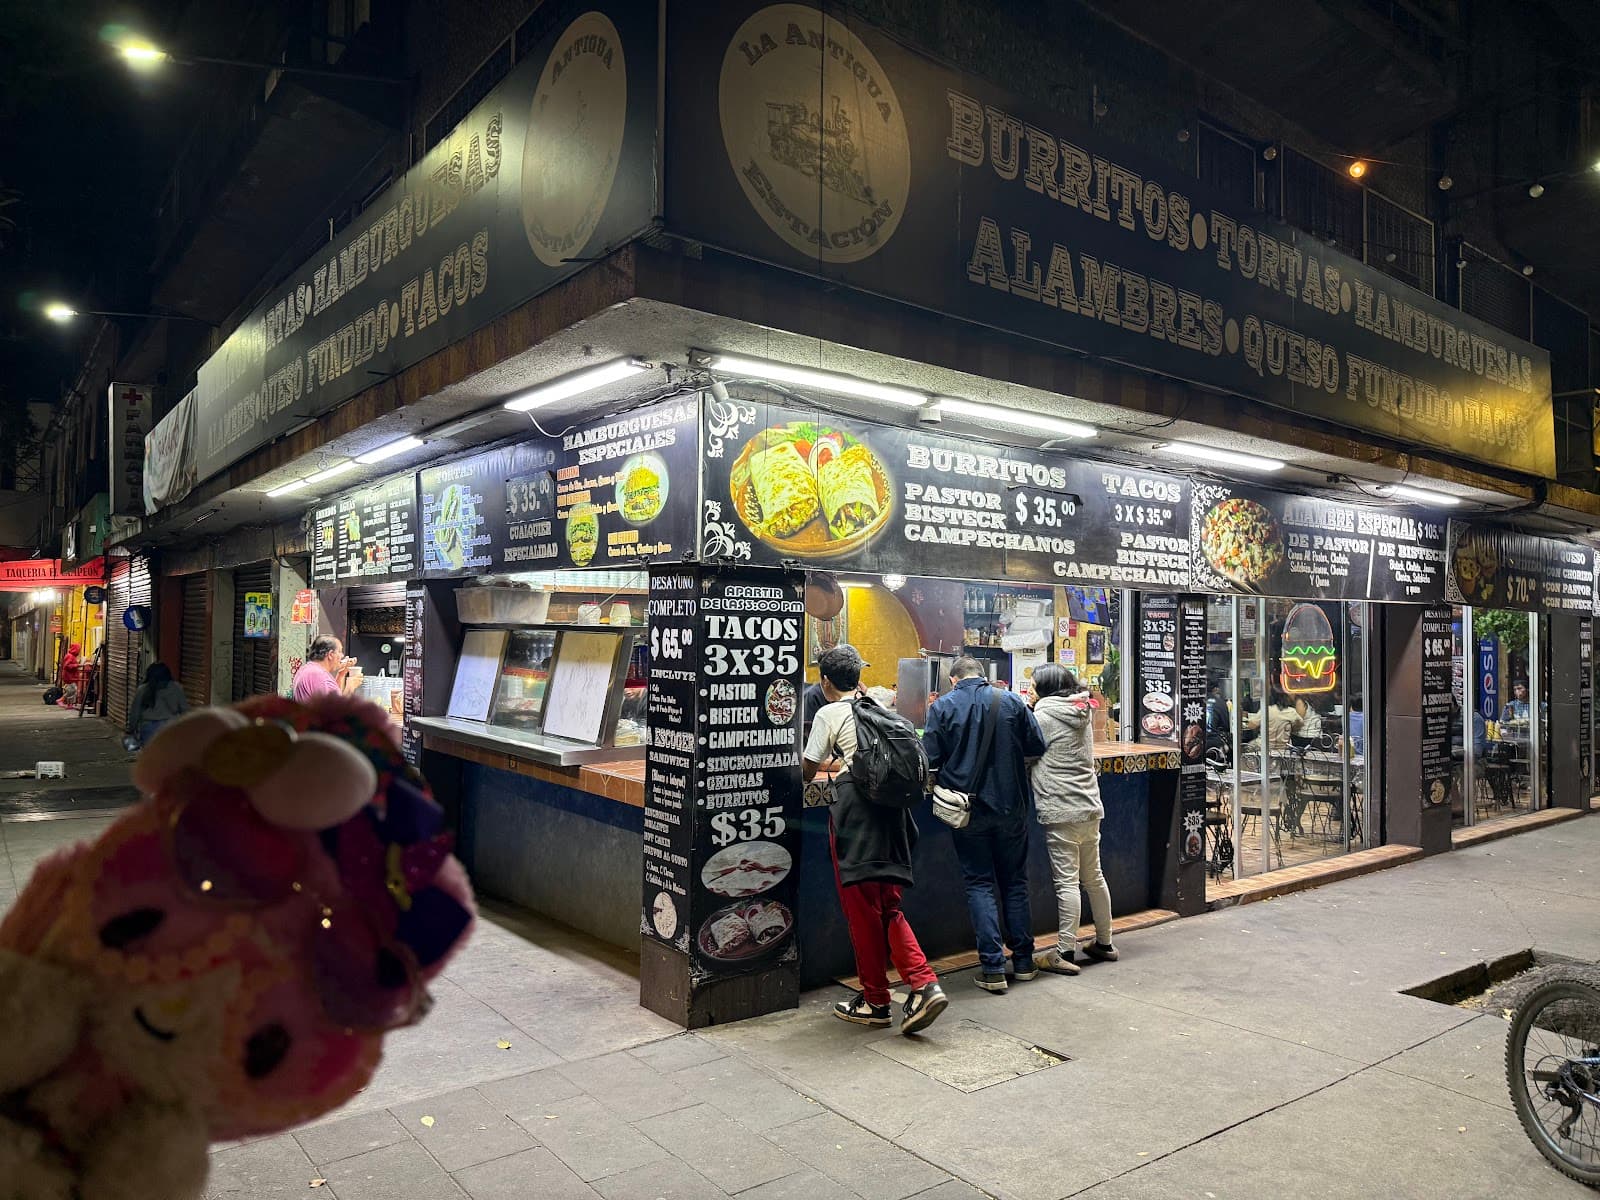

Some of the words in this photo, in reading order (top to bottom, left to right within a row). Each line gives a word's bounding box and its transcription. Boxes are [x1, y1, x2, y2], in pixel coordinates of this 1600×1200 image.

[738, 33, 778, 67] LA
[785, 23, 893, 123] ANTIGUA
[313, 110, 504, 318] HAMBURGUESAS
[946, 88, 1191, 252] BURRITOS
[1211, 209, 1341, 315] TORTAS
[1354, 277, 1534, 393] HAMBURGUESAS
[261, 356, 305, 425] QUESO
[306, 299, 391, 394] FUNDIDO
[401, 227, 489, 338] TACOS
[965, 216, 1223, 357] ALAMBRES
[1241, 313, 1341, 396] QUESO
[1345, 351, 1453, 432] FUNDIDO
[563, 399, 699, 452] HAMBURGUESAS
[578, 427, 677, 466] ESPECIALES
[907, 443, 1066, 489] BURRITOS
[905, 482, 1002, 511] PASTOR
[1102, 473, 1182, 504] TACOS
[905, 502, 1007, 531] BISTECK
[1282, 502, 1355, 533] ALAMBRE
[1357, 511, 1418, 541] ESPECIAL
[510, 521, 552, 541] CUALQUIER
[905, 524, 1077, 556] CAMPECHANOS
[1120, 531, 1191, 554] PASTOR
[504, 543, 559, 563] ESPECIALIDAD
[1288, 533, 1309, 548] DE
[1313, 537, 1370, 554] PASTOR
[1378, 542, 1396, 557] DE
[6, 567, 47, 578] TAQUERIA
[1117, 548, 1190, 573] BISTECK
[652, 575, 694, 591] DESAYUNO
[1053, 559, 1190, 587] CAMPECHANOS
[1562, 583, 1592, 596] PASTOR
[648, 599, 698, 616] COMPLETO
[704, 615, 799, 642] TACOS
[651, 668, 697, 682] INCLUYE
[1145, 680, 1172, 694] $35
[710, 683, 757, 701] PASTOR
[709, 707, 760, 725] BISTECK
[646, 726, 654, 746] A
[655, 727, 696, 754] ESCOGER
[709, 728, 796, 750] CAMPECHANOS
[649, 750, 690, 768] SANDWICH
[707, 752, 801, 773] SINCRONIZADA
[707, 772, 764, 791] GRINGAS
[706, 789, 771, 810] BURRITOS
[710, 805, 787, 848] $35
